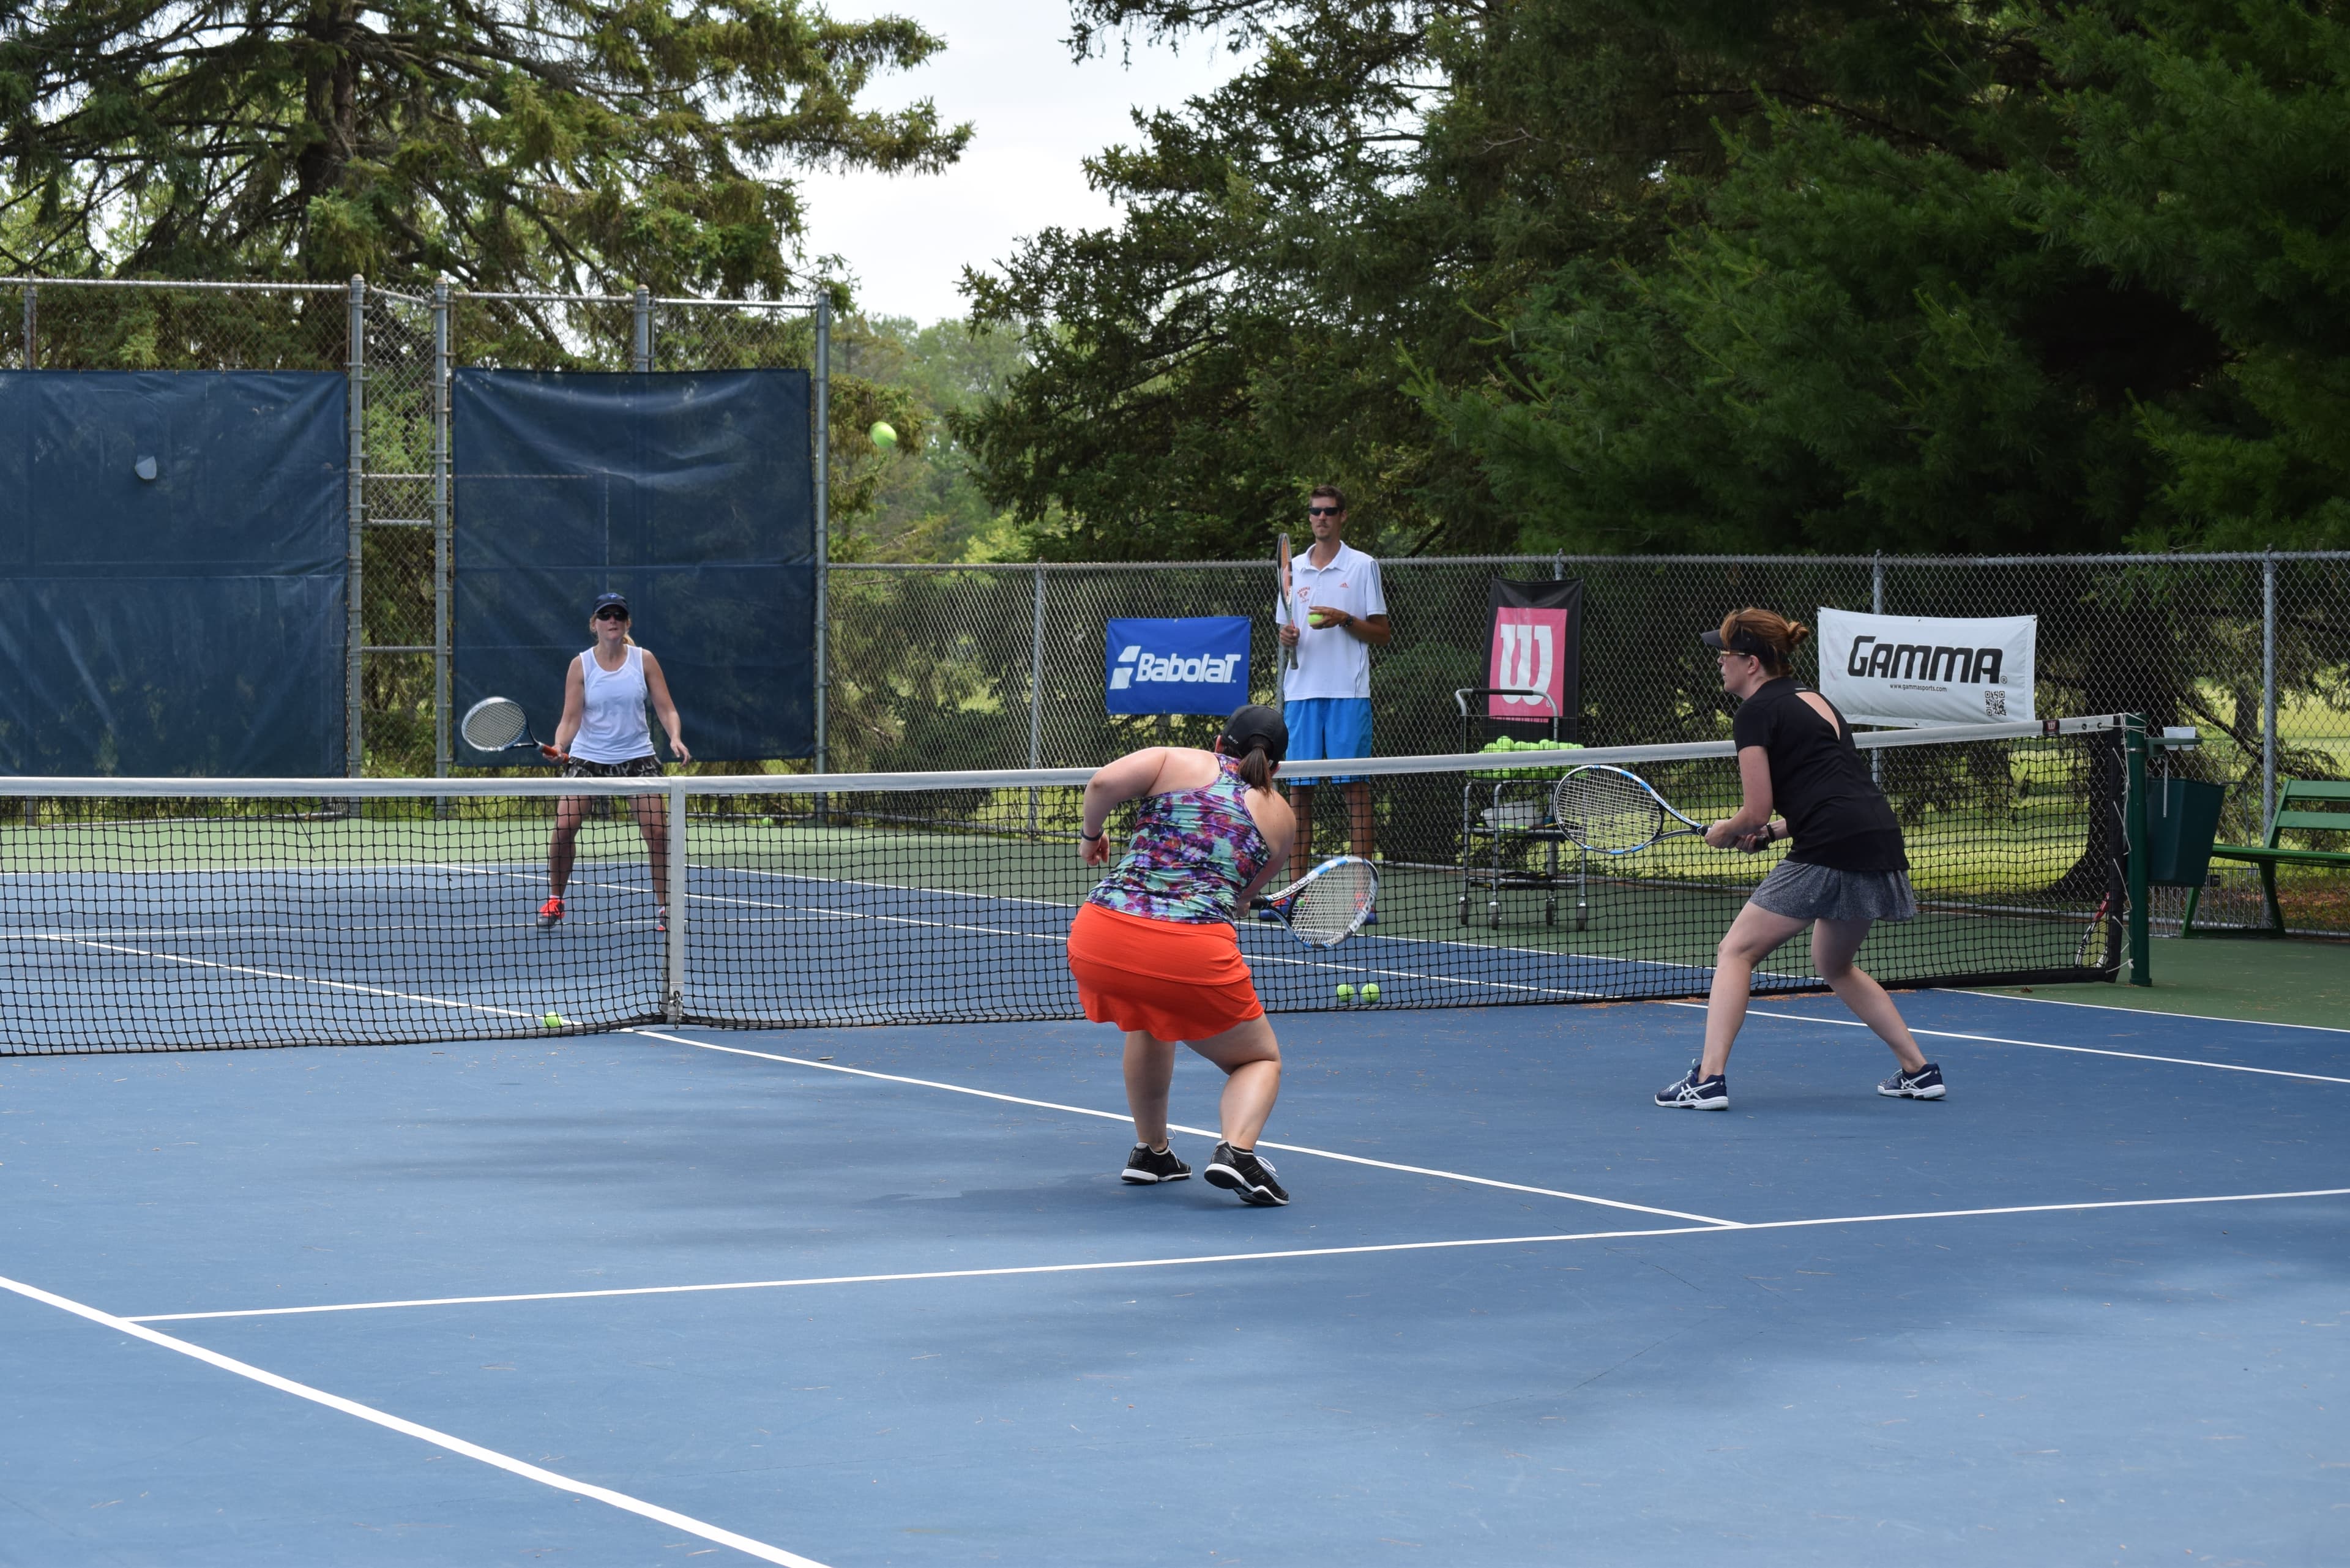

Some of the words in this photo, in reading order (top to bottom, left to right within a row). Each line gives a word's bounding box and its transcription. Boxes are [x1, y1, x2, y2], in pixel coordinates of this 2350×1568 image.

[1499, 624, 1553, 706] W
[1848, 635, 2002, 684] GAMMA
[1889, 684, 1947, 692] www.gammasports.com
